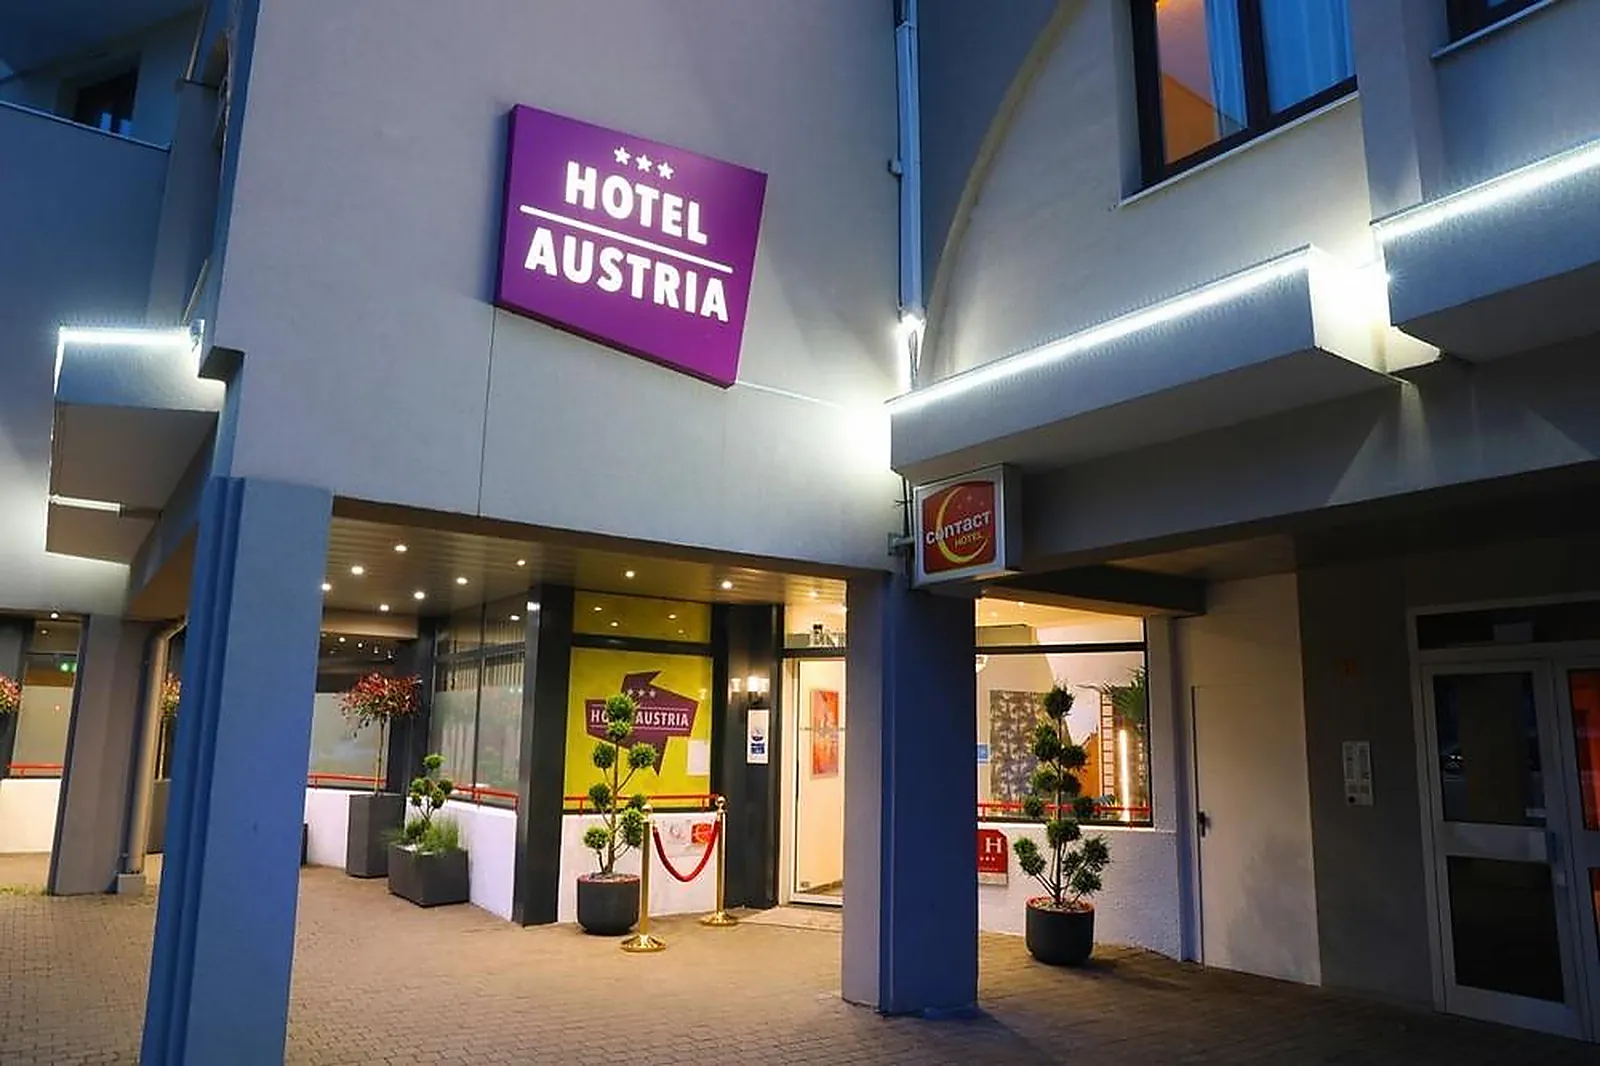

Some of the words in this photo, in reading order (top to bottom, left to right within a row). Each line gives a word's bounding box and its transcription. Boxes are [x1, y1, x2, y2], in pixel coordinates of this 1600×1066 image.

[565, 161, 707, 245] HOTEL
[524, 227, 728, 322] AUSTRIA
[635, 711, 689, 727] AUSTRIA
[985, 837, 1002, 853] H
